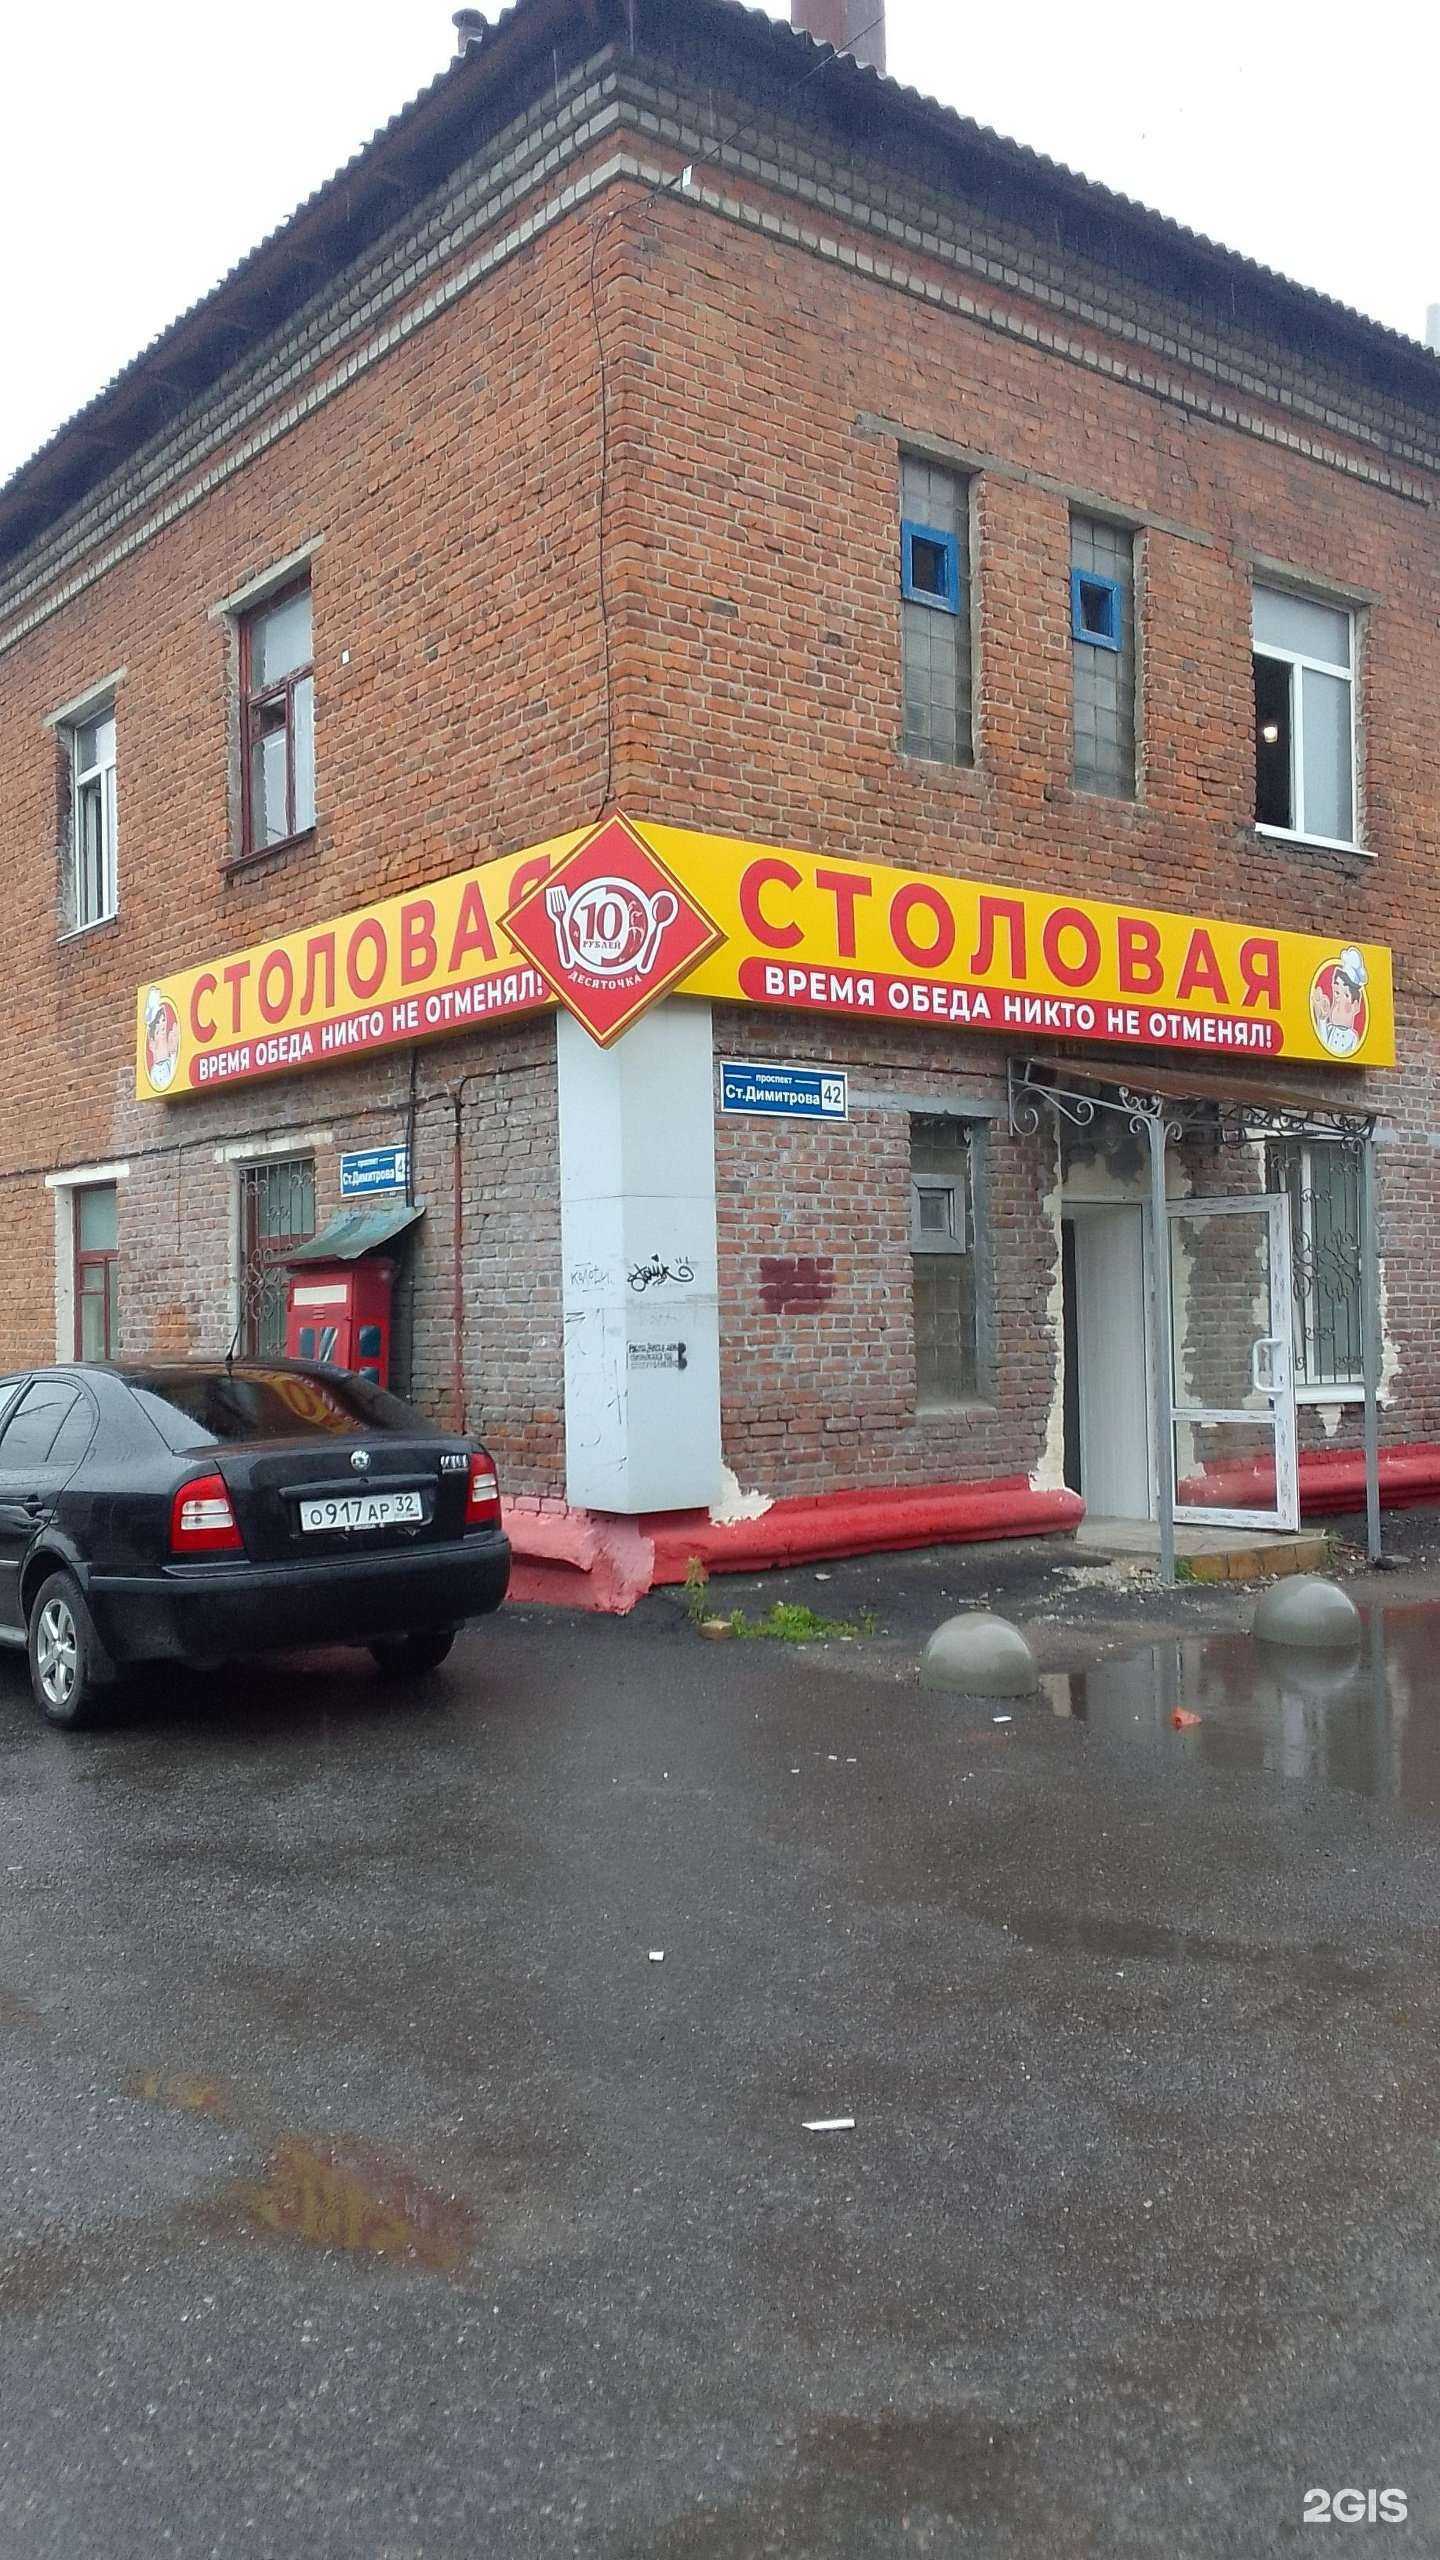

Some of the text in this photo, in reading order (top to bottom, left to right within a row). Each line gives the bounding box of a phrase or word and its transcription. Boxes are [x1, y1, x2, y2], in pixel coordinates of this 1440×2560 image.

[580, 901, 623, 941] 10
[583, 940, 621, 949] РУБЛЕЙ
[739, 858, 1281, 1010] СТОЛОВАЯ
[568, 969, 642, 990] ДЕСЯТОЧКА
[764, 966, 1272, 1048] ВРЕМЯ ОБЕДА НИКТО НЕ ОТМЕНЯЛ!
[199, 969, 543, 1081] ВРЕМЯ ОБЕДА НИКТО НЕ ОТМЕНЯЛ!
[755, 1073, 793, 1084] проспект
[725, 1084, 841, 1106] Ст.Димитрова 42
[394, 1495, 414, 1512] 32
